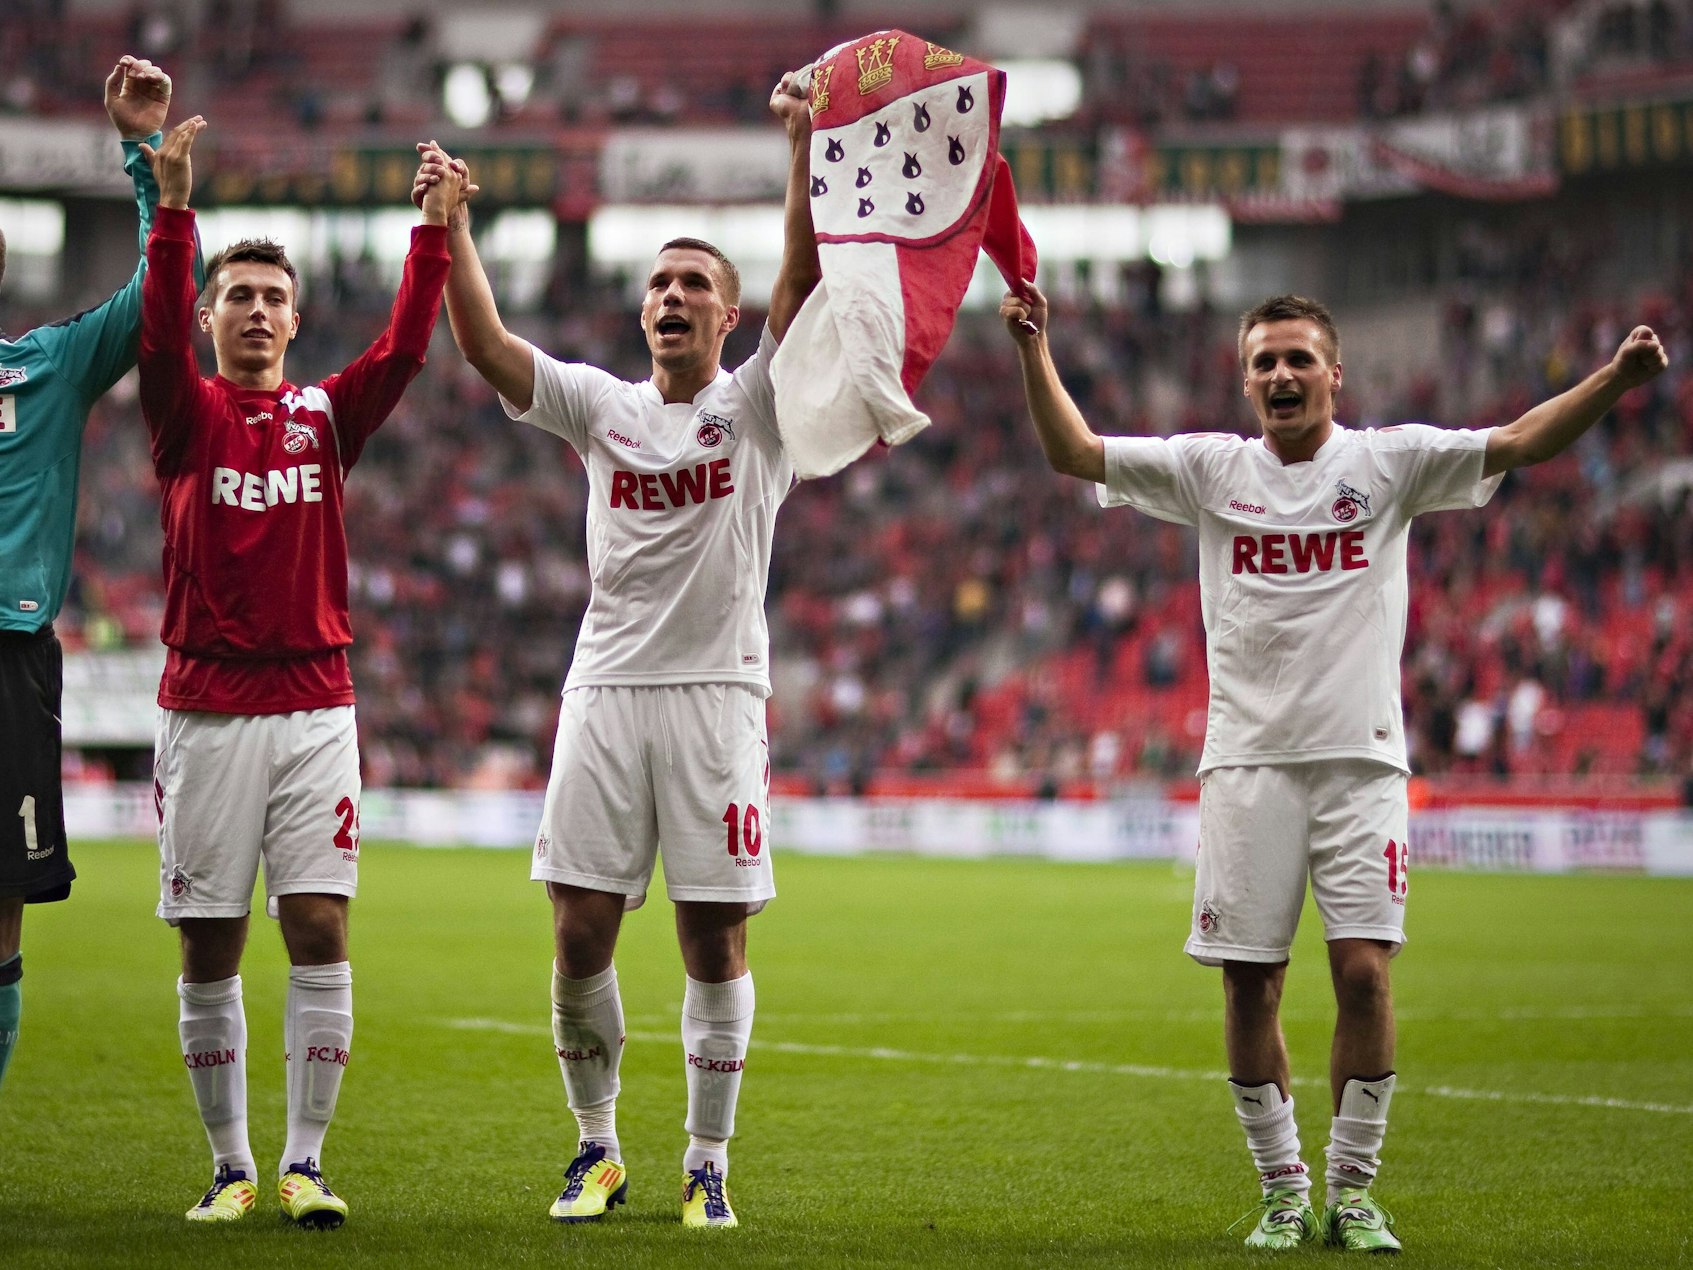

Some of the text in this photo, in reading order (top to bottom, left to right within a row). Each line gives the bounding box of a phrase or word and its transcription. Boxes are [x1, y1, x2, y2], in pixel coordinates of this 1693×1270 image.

[246, 411, 273, 425] Reebo
[606, 429, 641, 449] Reebok
[212, 463, 323, 512] REWE
[610, 457, 735, 510] REWE
[1229, 499, 1267, 515] Reebok
[1231, 530, 1370, 575] REWE
[17, 795, 38, 850] 1
[333, 796, 360, 851] 2
[722, 802, 762, 857] 10
[184, 1048, 236, 1069] C.KÖLN
[306, 1045, 349, 1067] FC.KÖ
